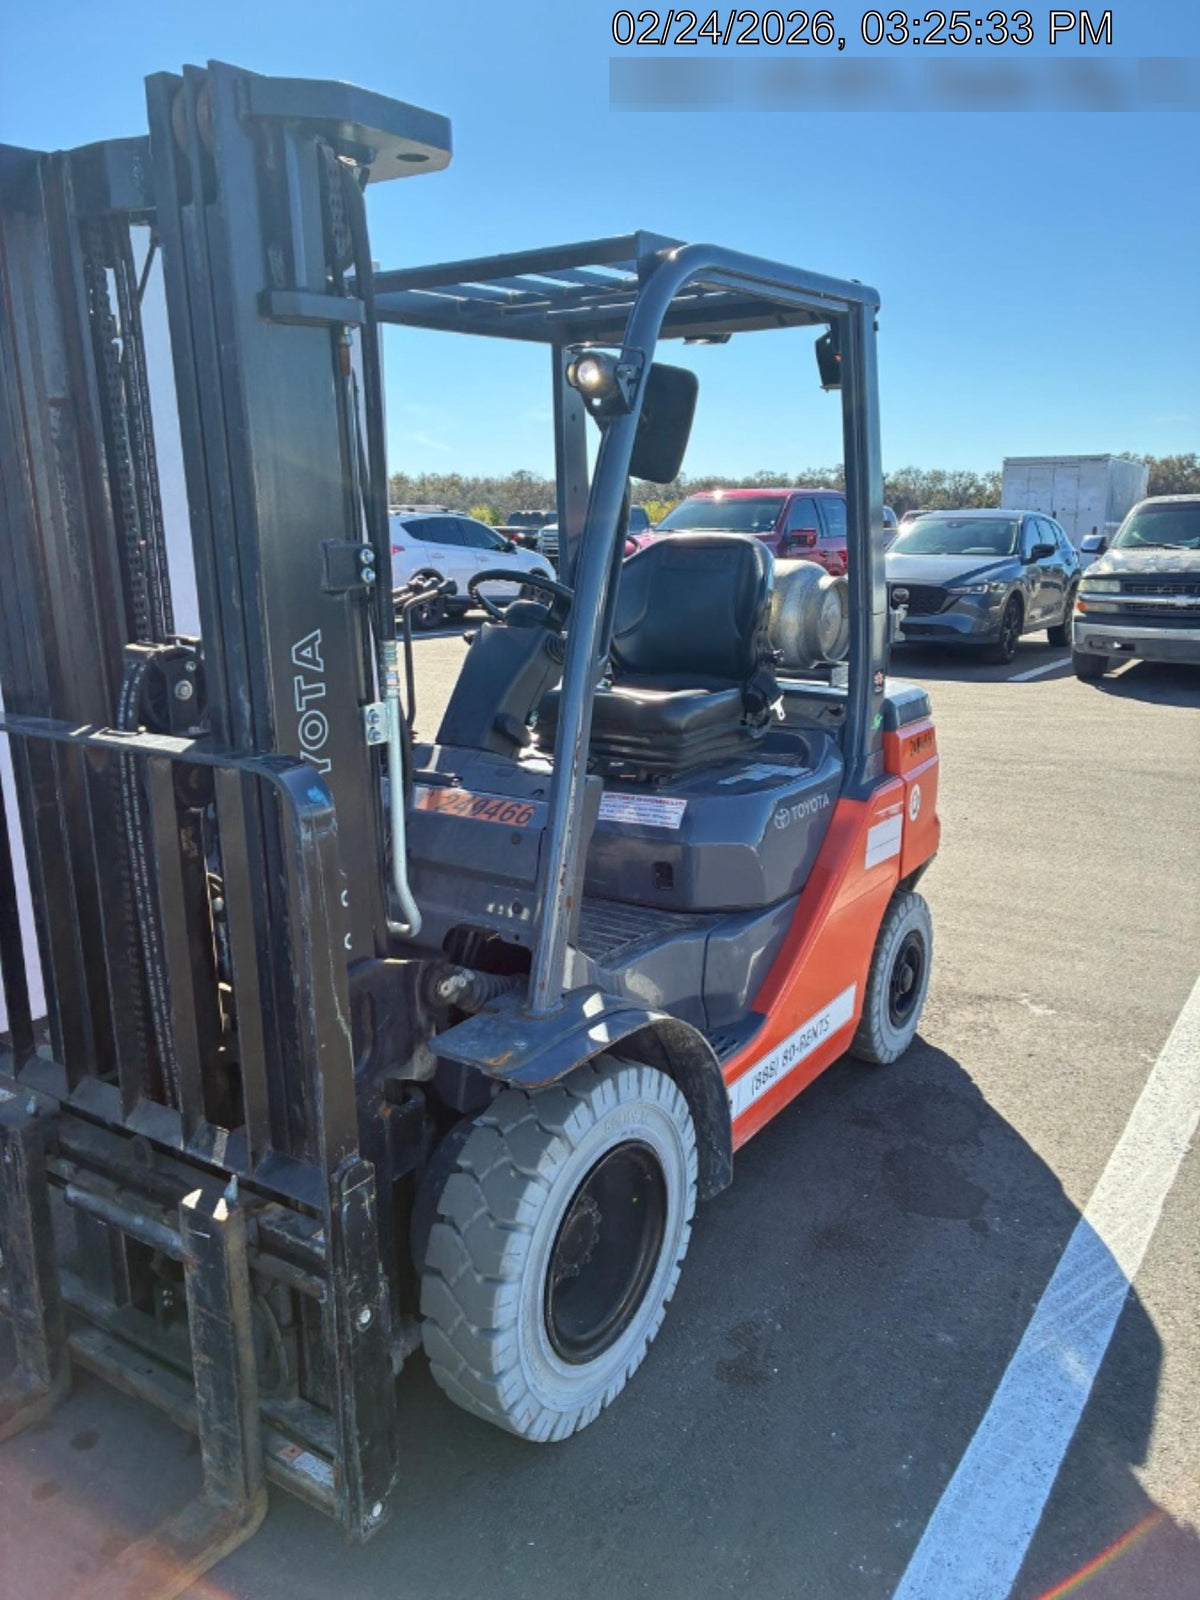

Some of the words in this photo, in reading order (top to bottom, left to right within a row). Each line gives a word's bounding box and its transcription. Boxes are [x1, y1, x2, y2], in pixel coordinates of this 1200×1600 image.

[291, 628, 331, 774] YOTA
[790, 792, 830, 821] TOYOTA
[781, 1013, 830, 1068] 80-RENTS
